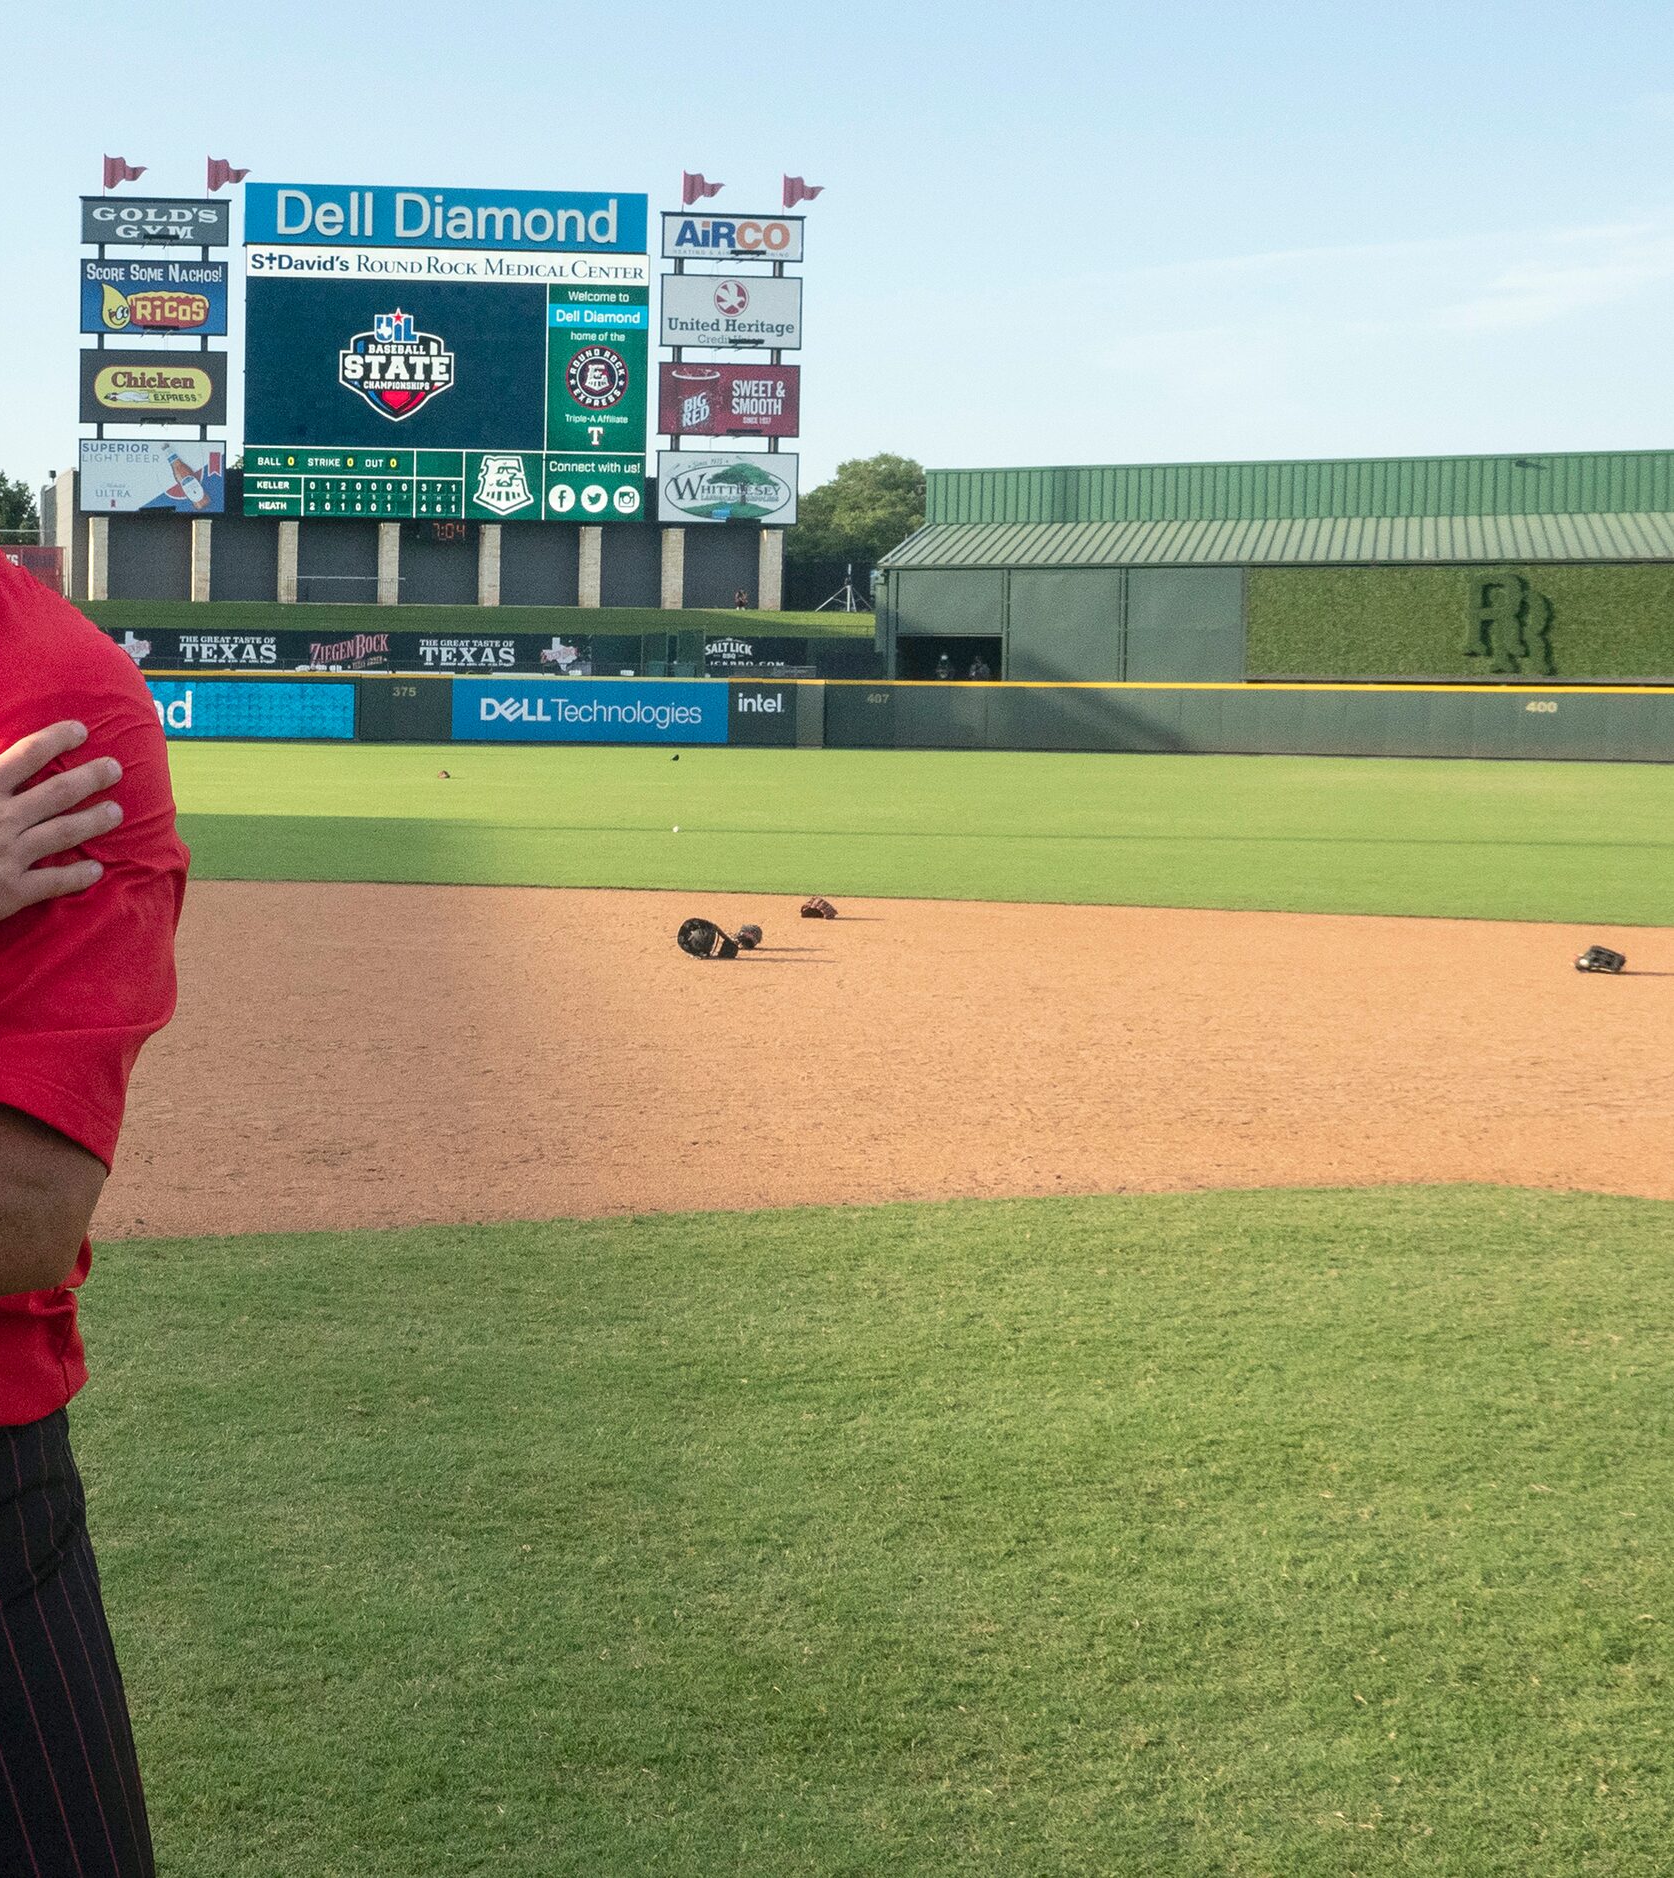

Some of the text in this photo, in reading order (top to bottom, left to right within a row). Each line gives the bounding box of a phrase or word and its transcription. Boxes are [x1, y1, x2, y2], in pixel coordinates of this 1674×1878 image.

[92, 207, 218, 223] GOLD'S
[277, 189, 618, 244] Dell Diamond
[115, 224, 194, 239] GYM
[357, 254, 423, 274] ROUND
[426, 256, 478, 275] ROCK
[484, 258, 569, 278] MEDICAL
[571, 260, 644, 280] CENTER
[568, 291, 630, 303] Welcome to
[556, 309, 641, 324] Dell Diamond
[668, 317, 795, 337] United Heritage
[570, 331, 626, 342] home of the
[368, 344, 426, 355] BASEBALL
[344, 355, 450, 381] STATE
[569, 348, 626, 376] ROUND ROCK
[111, 371, 195, 389] Chicken
[363, 381, 430, 390] CHAMPIONSHIPS
[731, 380, 786, 398] SWEET &
[153, 393, 197, 402] EXPRESS
[573, 388, 621, 407] EXPRESS
[683, 391, 707, 414] BIG
[731, 398, 782, 415] SMOOTH
[597, 415, 629, 424] Affiliate
[682, 405, 710, 428] RED
[82, 443, 149, 453] SUPERIOR
[82, 453, 160, 463] LIGHT BEER
[257, 456, 397, 468] BALL 0 STRIKE 0 OUT 0
[549, 461, 641, 474] Connect with us!
[256, 481, 290, 490] KELLER
[309, 481, 316, 490] 0
[340, 482, 346, 491] 2
[355, 482, 362, 491] 0
[370, 482, 377, 491] 0
[386, 482, 392, 491] 0
[401, 483, 408, 492] 0
[420, 483, 427, 492] 3
[436, 484, 442, 492] 7
[258, 501, 287, 510] HEATH
[309, 502, 316, 511] 2
[324, 502, 331, 511] 0
[355, 503, 361, 511] 0
[370, 503, 377, 512] 0
[420, 503, 427, 512] 4
[436, 504, 442, 513] 6
[179, 635, 199, 643] THE
[200, 636, 231, 644] GREAT
[233, 636, 262, 644] TASTE
[419, 639, 439, 647] THE
[440, 639, 470, 647] GREAT
[502, 640, 515, 648] OF
[179, 643, 277, 664] TEXAS
[705, 642, 753, 656] SALT LICK
[419, 647, 516, 667] TEXAS
[392, 687, 417, 697] 375
[738, 692, 782, 713] intel
[1525, 701, 1558, 713] 400
[480, 697, 703, 730] DELL Technologies
